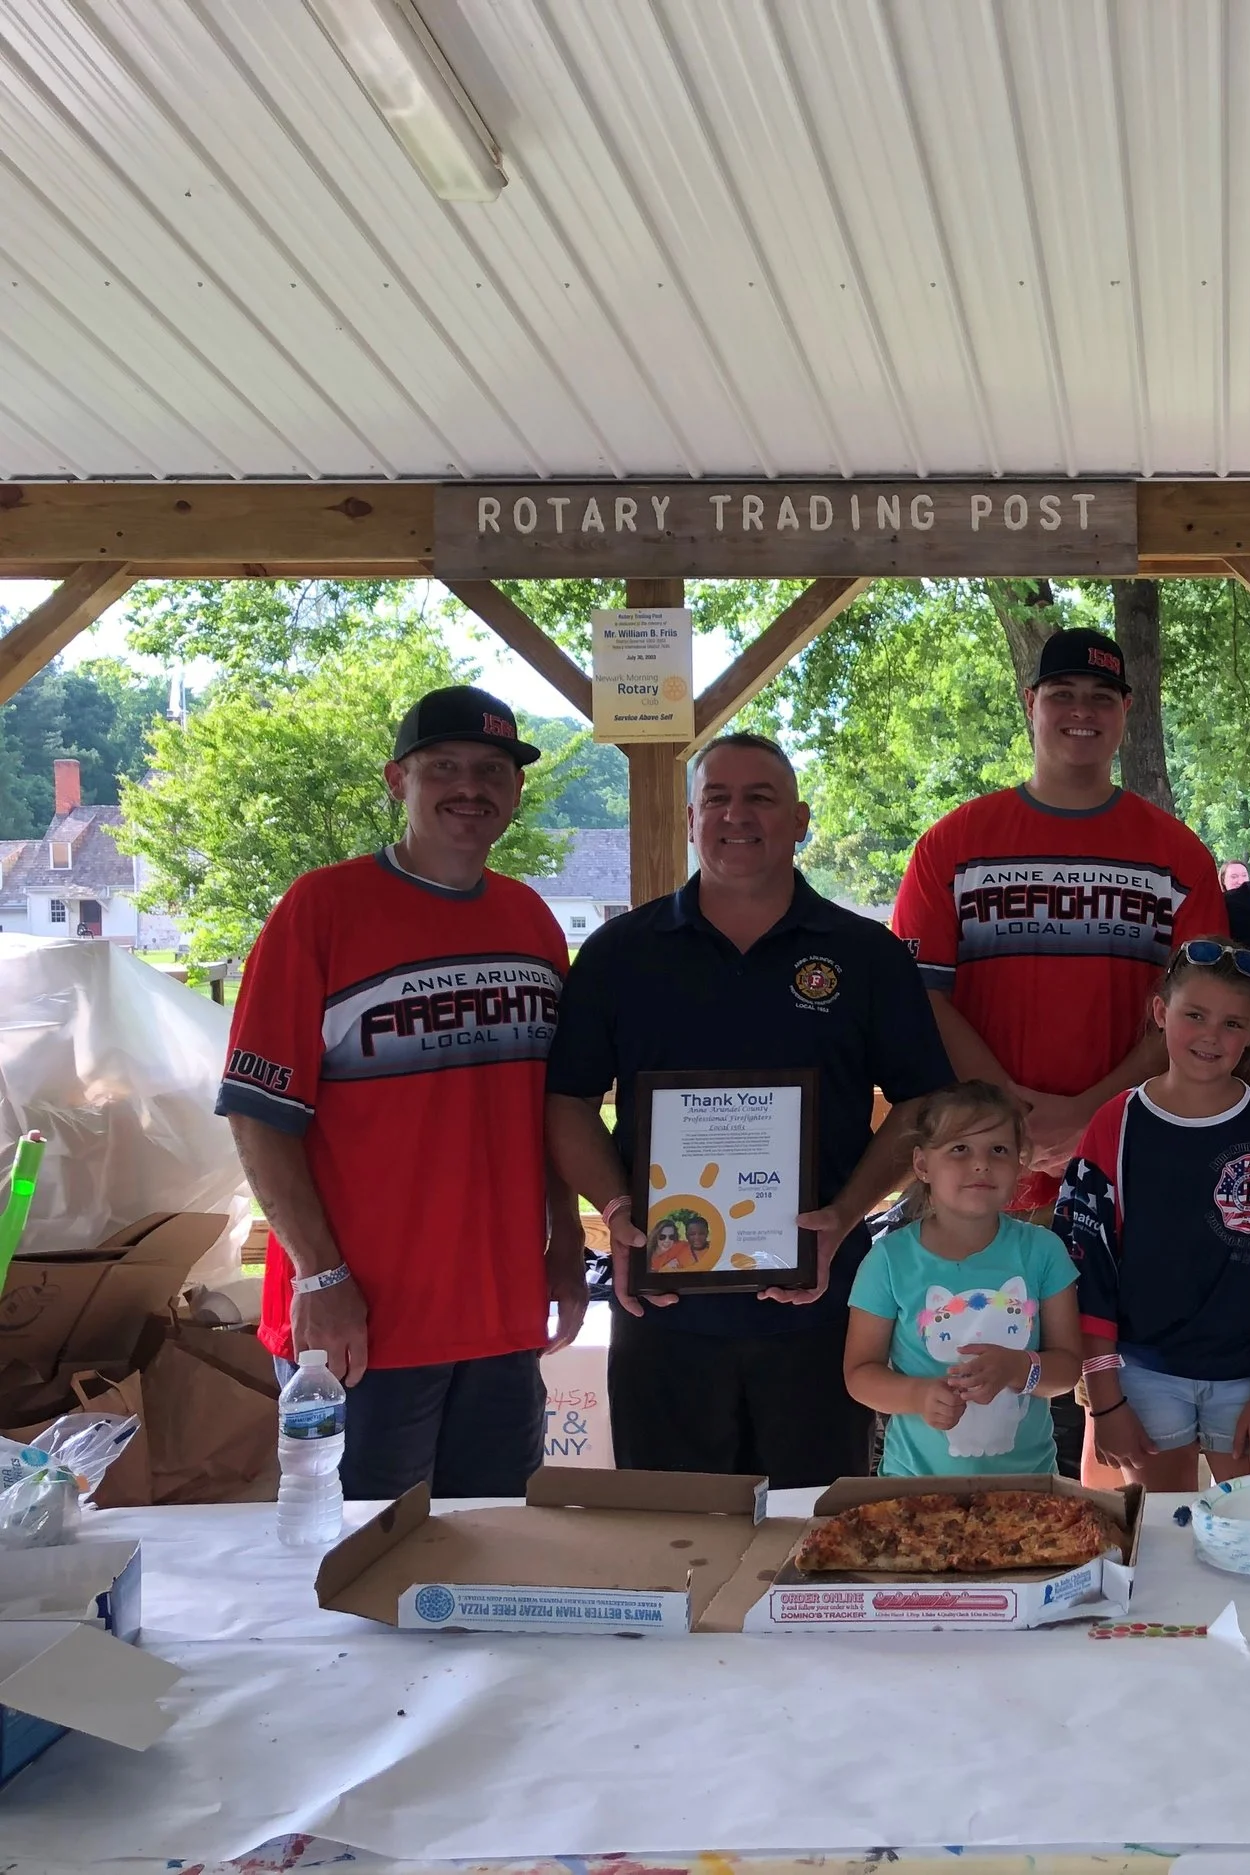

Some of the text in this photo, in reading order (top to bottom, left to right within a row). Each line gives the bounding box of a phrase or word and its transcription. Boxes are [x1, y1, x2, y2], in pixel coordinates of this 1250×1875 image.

[479, 493, 1096, 533] ROTARY TRADING POST
[604, 628, 678, 638] Mr. William B. Friis
[595, 674, 658, 683] Newark Morning
[617, 683, 659, 696] Rotary
[641, 698, 659, 706] Club
[638, 713, 659, 721] Above
[982, 871, 1154, 889] ANNE ARUNDEL
[958, 884, 1174, 946] FIREFIGHTERS
[995, 922, 1141, 939] LOCAL 1563
[401, 969, 556, 995] ANNE ARUNDEL
[795, 1003, 816, 1011] LOCAL
[421, 1028, 499, 1051] LOCAL
[680, 1092, 773, 1107] Thank You!
[710, 1105, 741, 1113] Arundel
[742, 1105, 768, 1113] County
[683, 1114, 772, 1124] Professional Firefighters
[738, 1171, 780, 1185] MDA
[562, 1411, 588, 1434] &
[781, 1592, 865, 1604] ORDER ONLINE
[459, 1603, 662, 1622] WHAT'S BETTER THAN PIZZA? FREE PIZZA.
